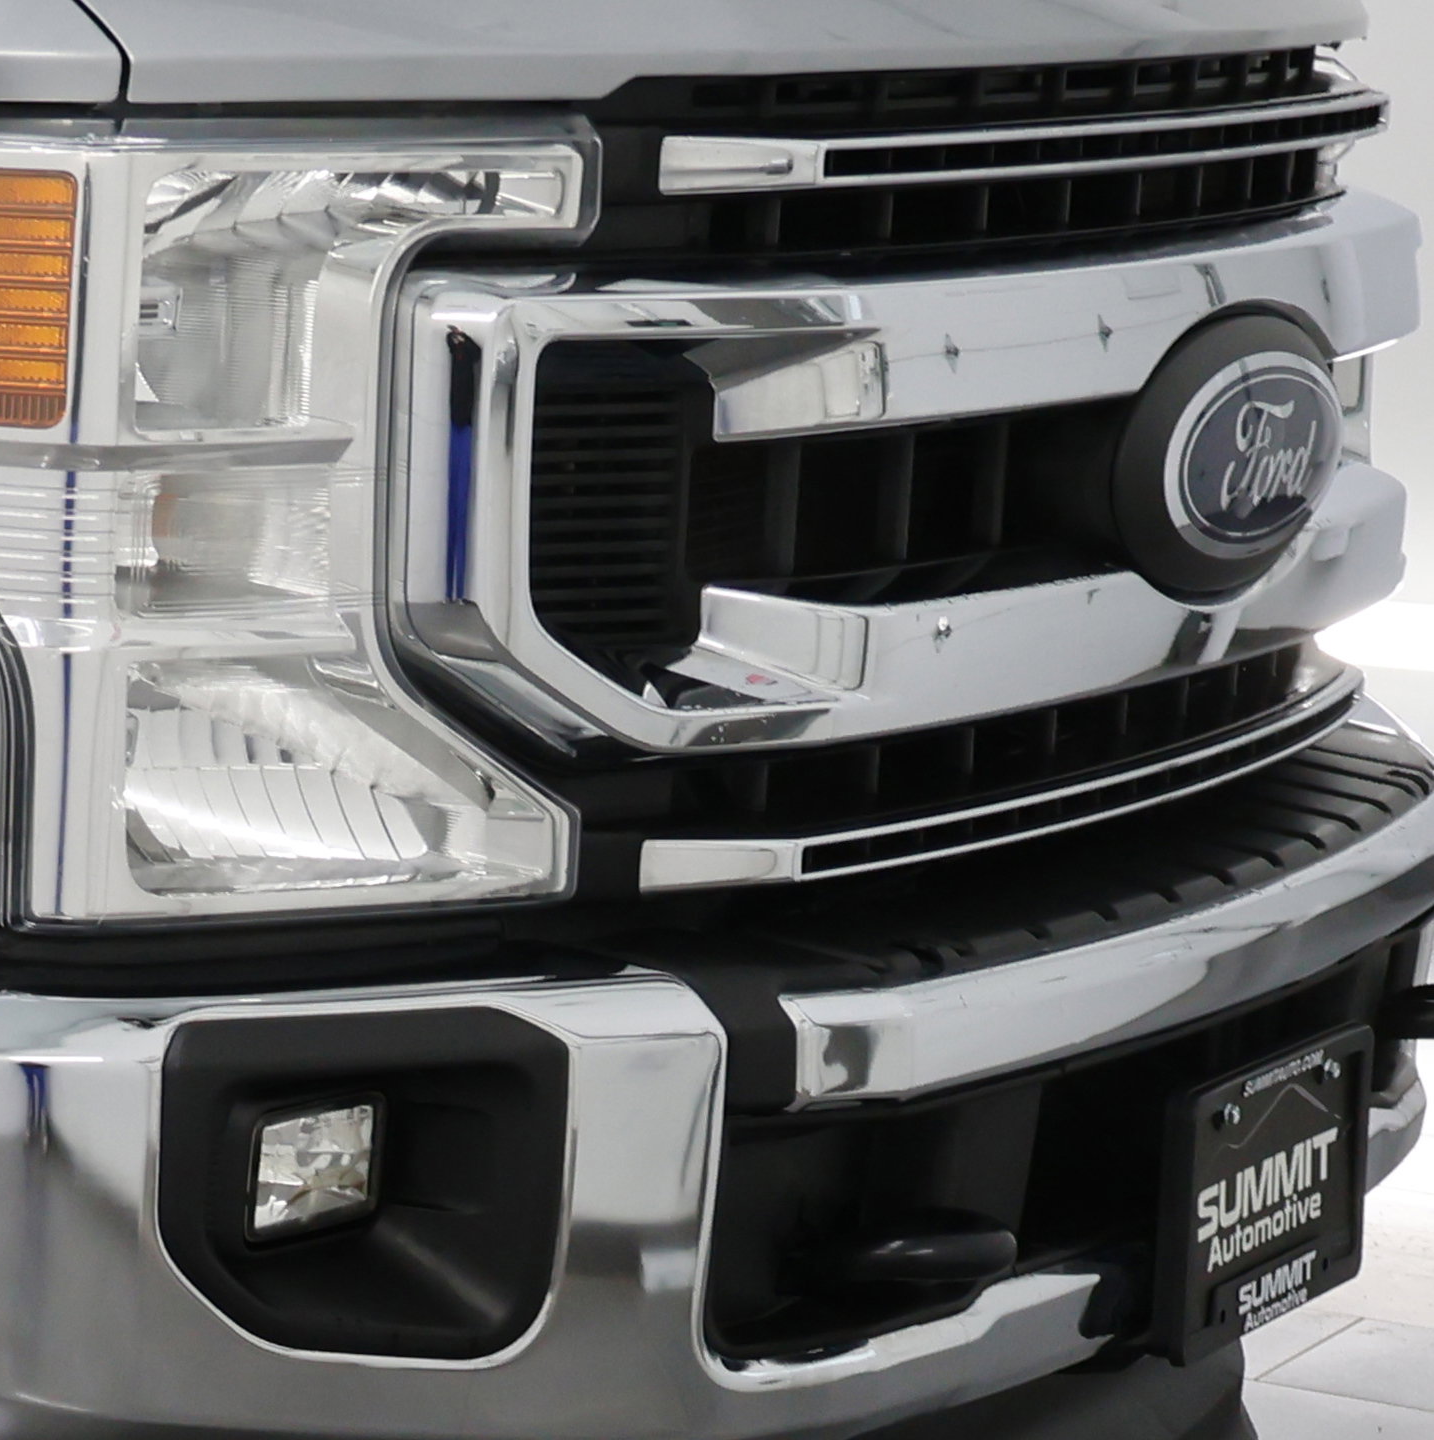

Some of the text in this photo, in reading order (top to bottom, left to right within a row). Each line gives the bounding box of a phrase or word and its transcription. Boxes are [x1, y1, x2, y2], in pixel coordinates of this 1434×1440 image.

[1220, 401, 1316, 511] Ford
[1197, 1127, 1338, 1243] SUMMIT
[1207, 1192, 1321, 1273] Automotive
[1238, 1250, 1317, 1315] SUMMIT
[1243, 1286, 1307, 1332] Automotive
